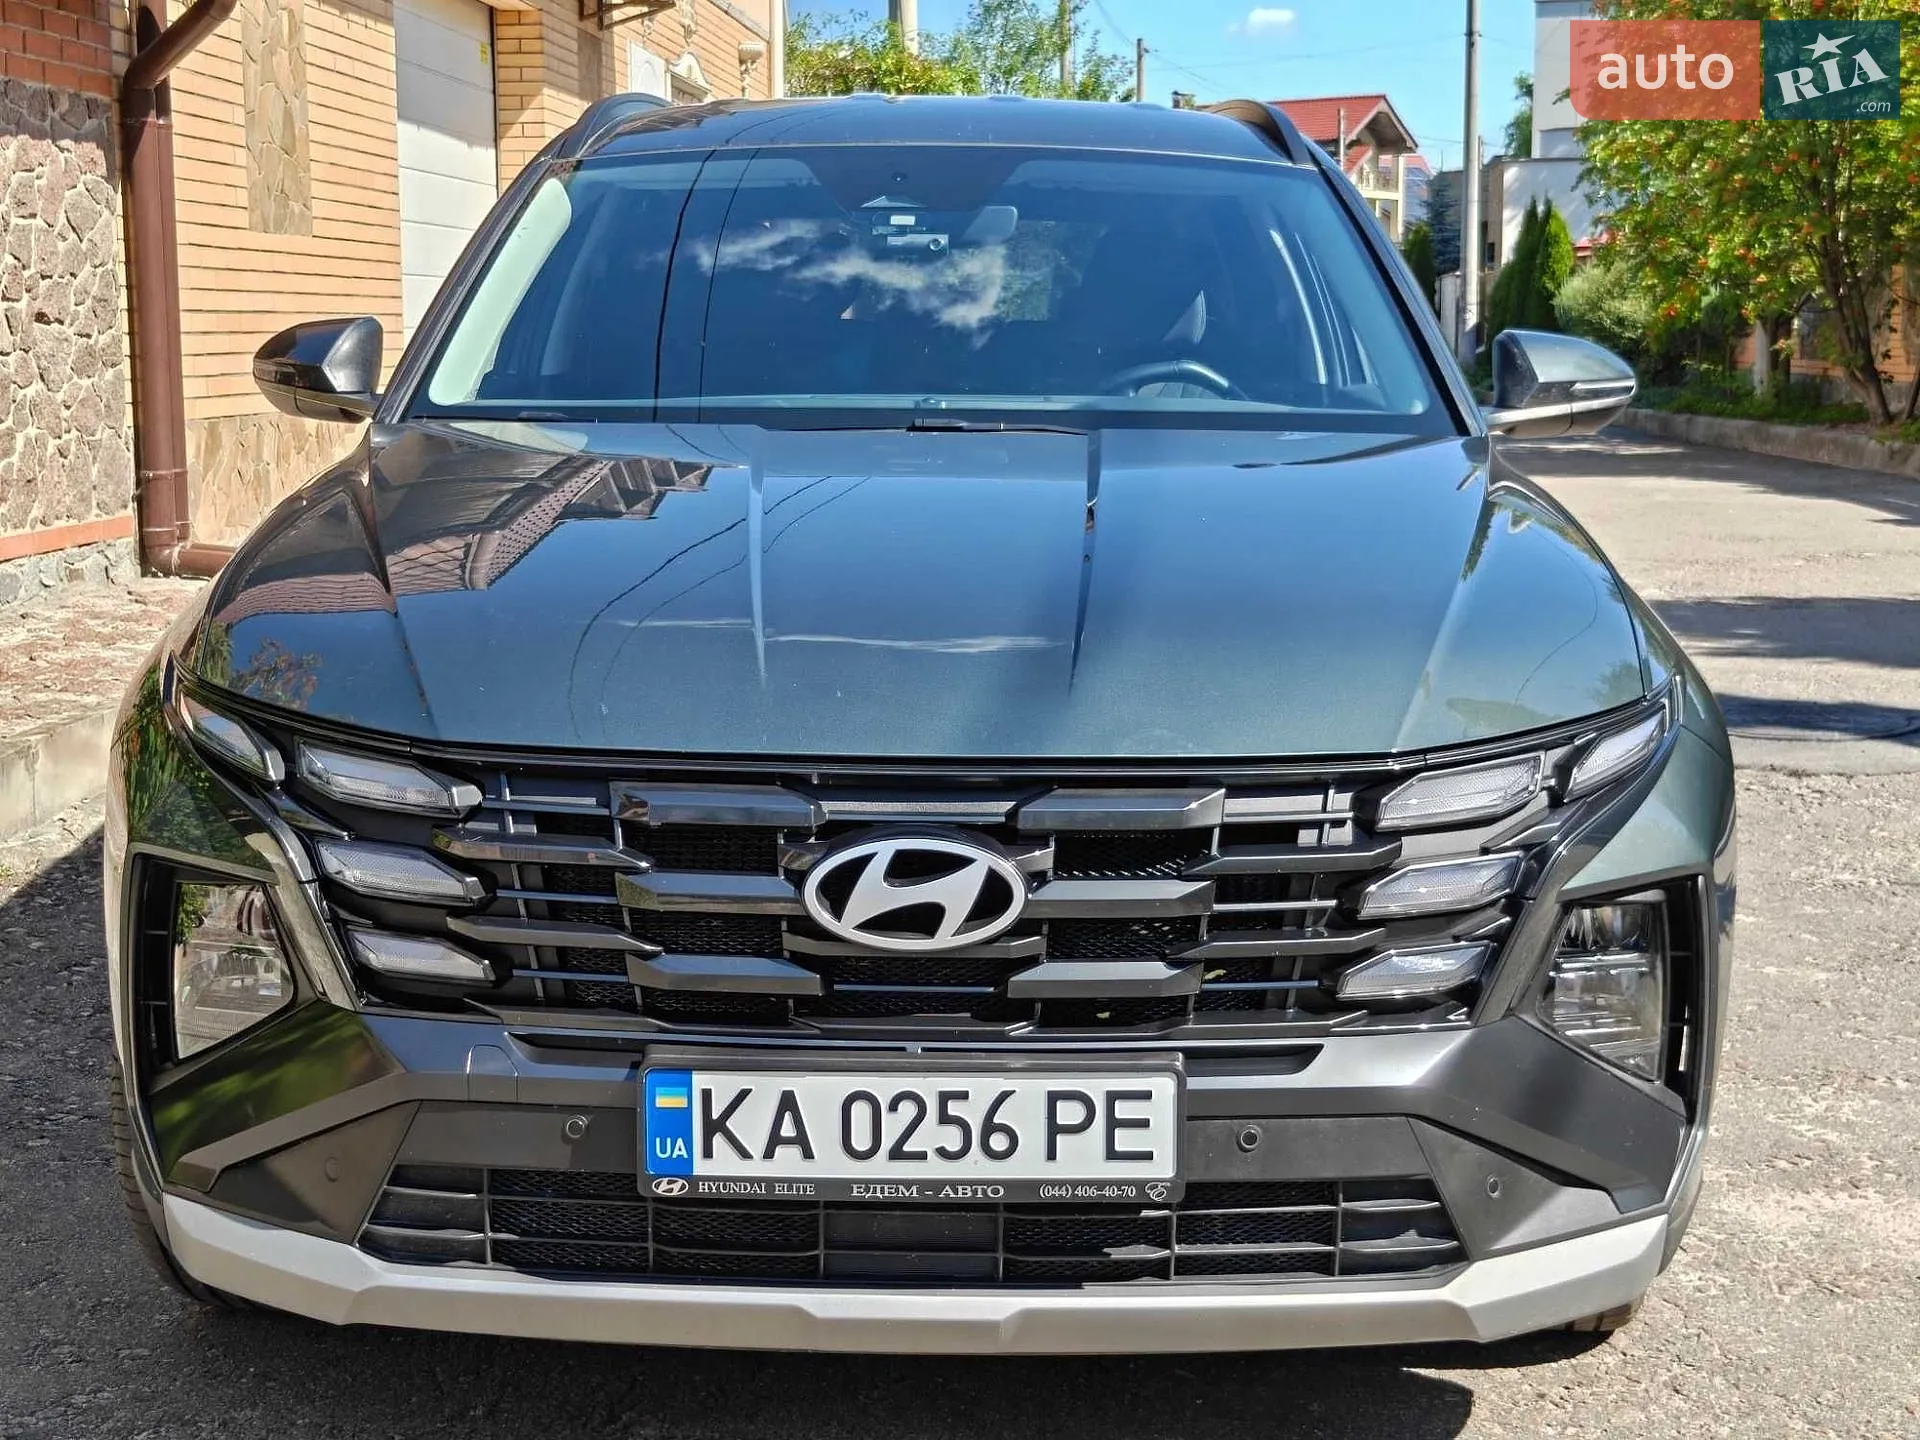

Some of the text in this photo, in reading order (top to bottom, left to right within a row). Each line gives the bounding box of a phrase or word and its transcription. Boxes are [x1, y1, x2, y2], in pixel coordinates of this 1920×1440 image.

[700, 1088, 1154, 1161] KA 0256 PE
[655, 1137, 688, 1159] UA
[698, 1181, 815, 1195] HYUNDAI ELITE
[851, 1184, 919, 1198] ЕДЕМ
[938, 1185, 1005, 1198] АВТО
[1039, 1184, 1136, 1198] (044) 406-40-70
